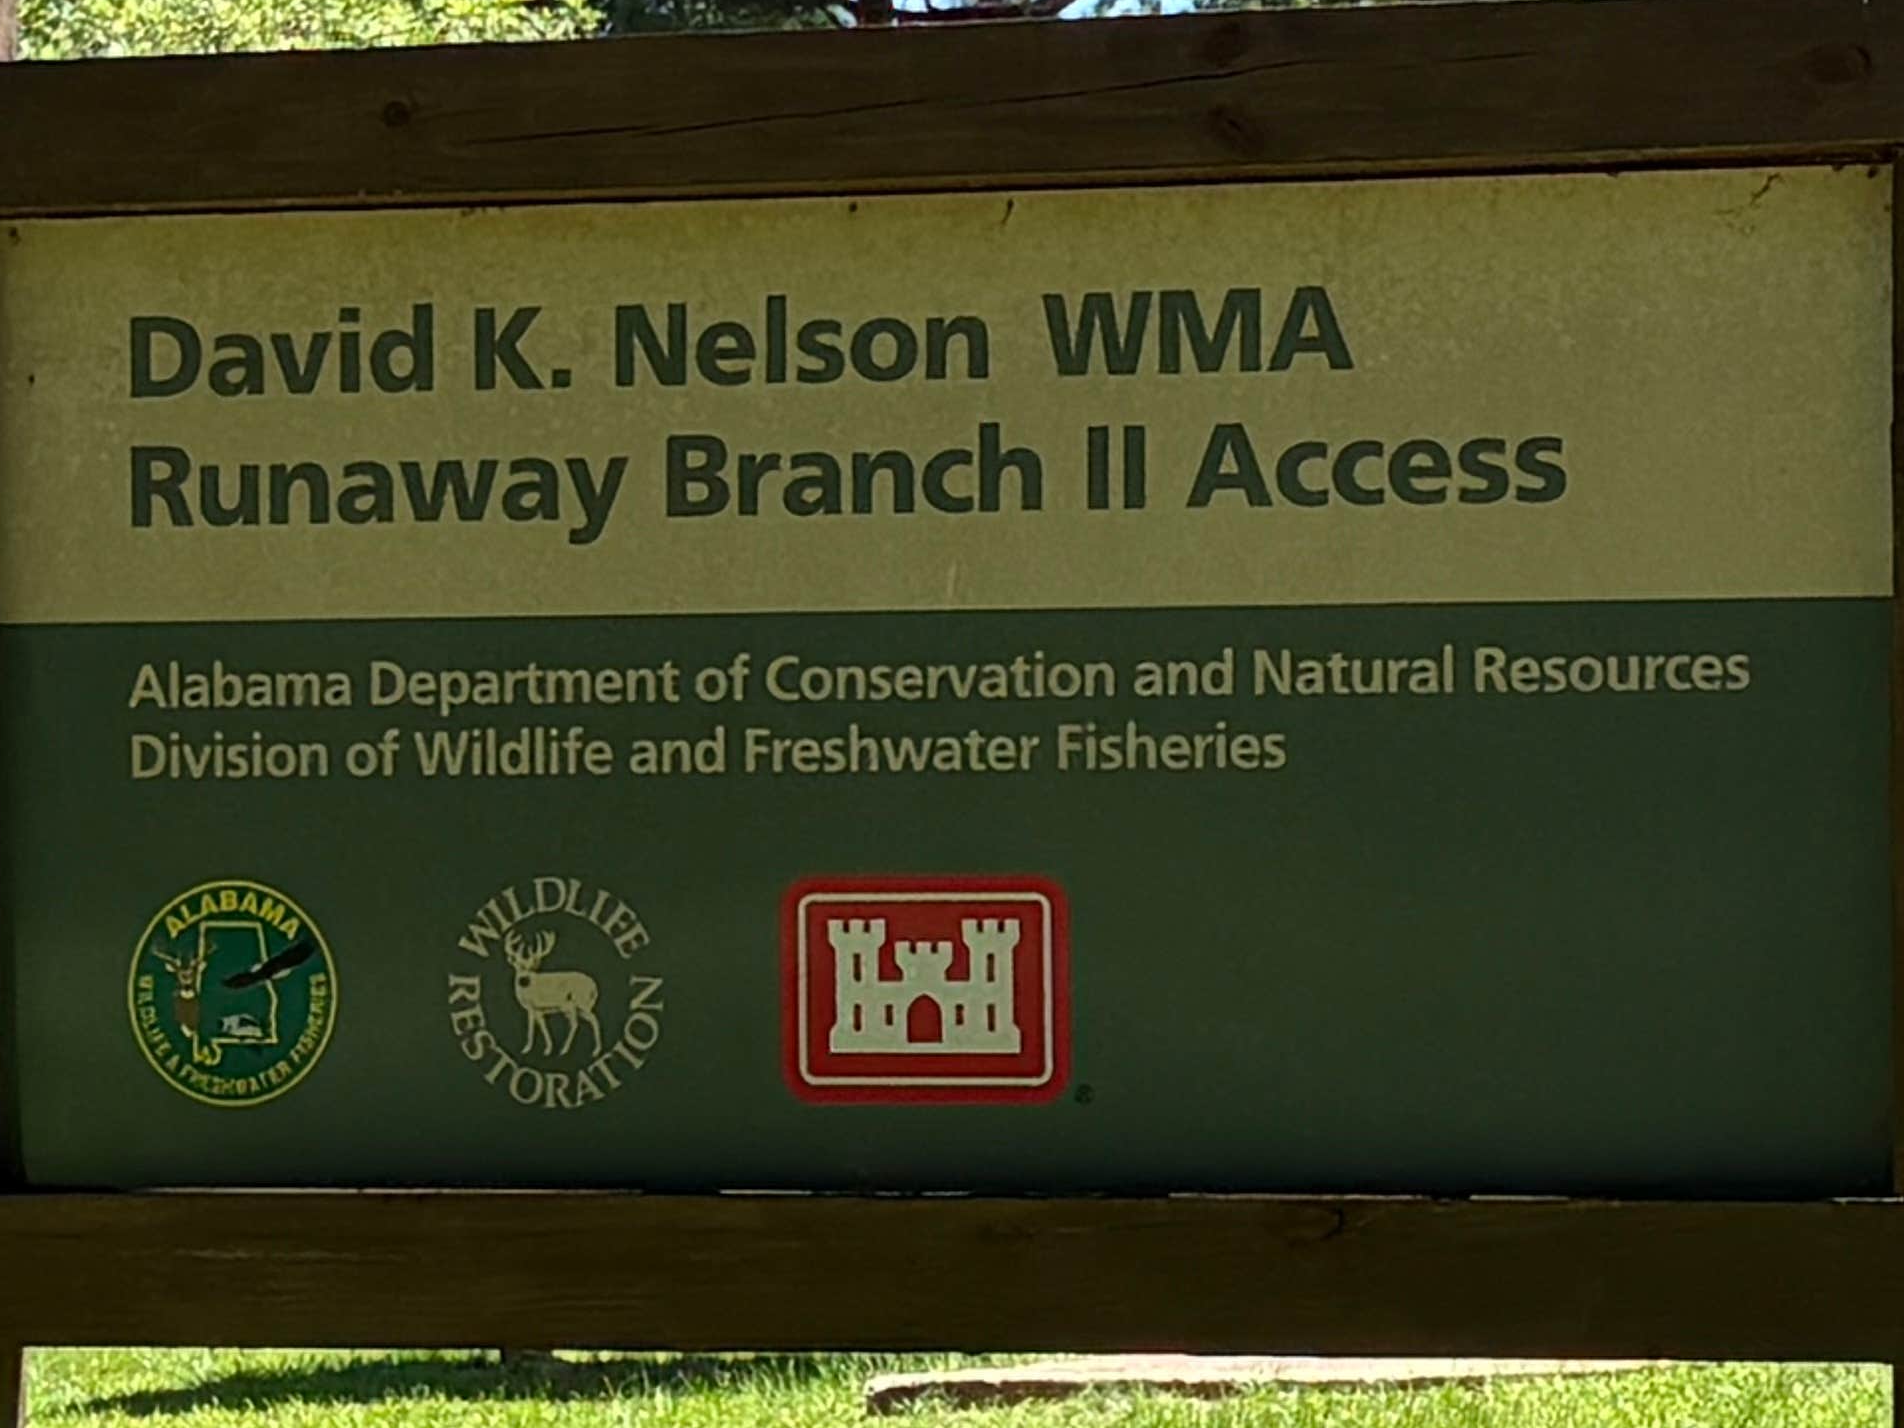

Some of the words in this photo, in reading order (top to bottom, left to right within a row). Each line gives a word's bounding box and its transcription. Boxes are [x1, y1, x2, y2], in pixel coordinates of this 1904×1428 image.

[128, 303, 434, 399] David
[474, 304, 572, 391] K.
[614, 294, 990, 388] Nelson
[1041, 285, 1355, 377] WMA
[129, 445, 629, 546] Runaway
[665, 422, 1043, 518] Branch
[1086, 424, 1147, 511] II
[1185, 422, 1567, 509] Access
[128, 660, 352, 709] Alabama
[370, 660, 680, 716] Department
[695, 652, 751, 702] of
[765, 650, 1115, 701] Conservation
[1133, 646, 1234, 697] and
[1253, 643, 1454, 696] Natural
[1474, 646, 1750, 694] Resources
[131, 730, 328, 779] Division
[346, 728, 400, 777] of
[413, 726, 614, 776] Wildlife
[629, 725, 726, 774] and
[744, 723, 1041, 773] Freshwater
[1057, 720, 1286, 770] Fisheries
[163, 889, 302, 940] ALABAMA
[457, 876, 651, 959] WILDLIFE
[448, 972, 664, 1109] RESTORATION
